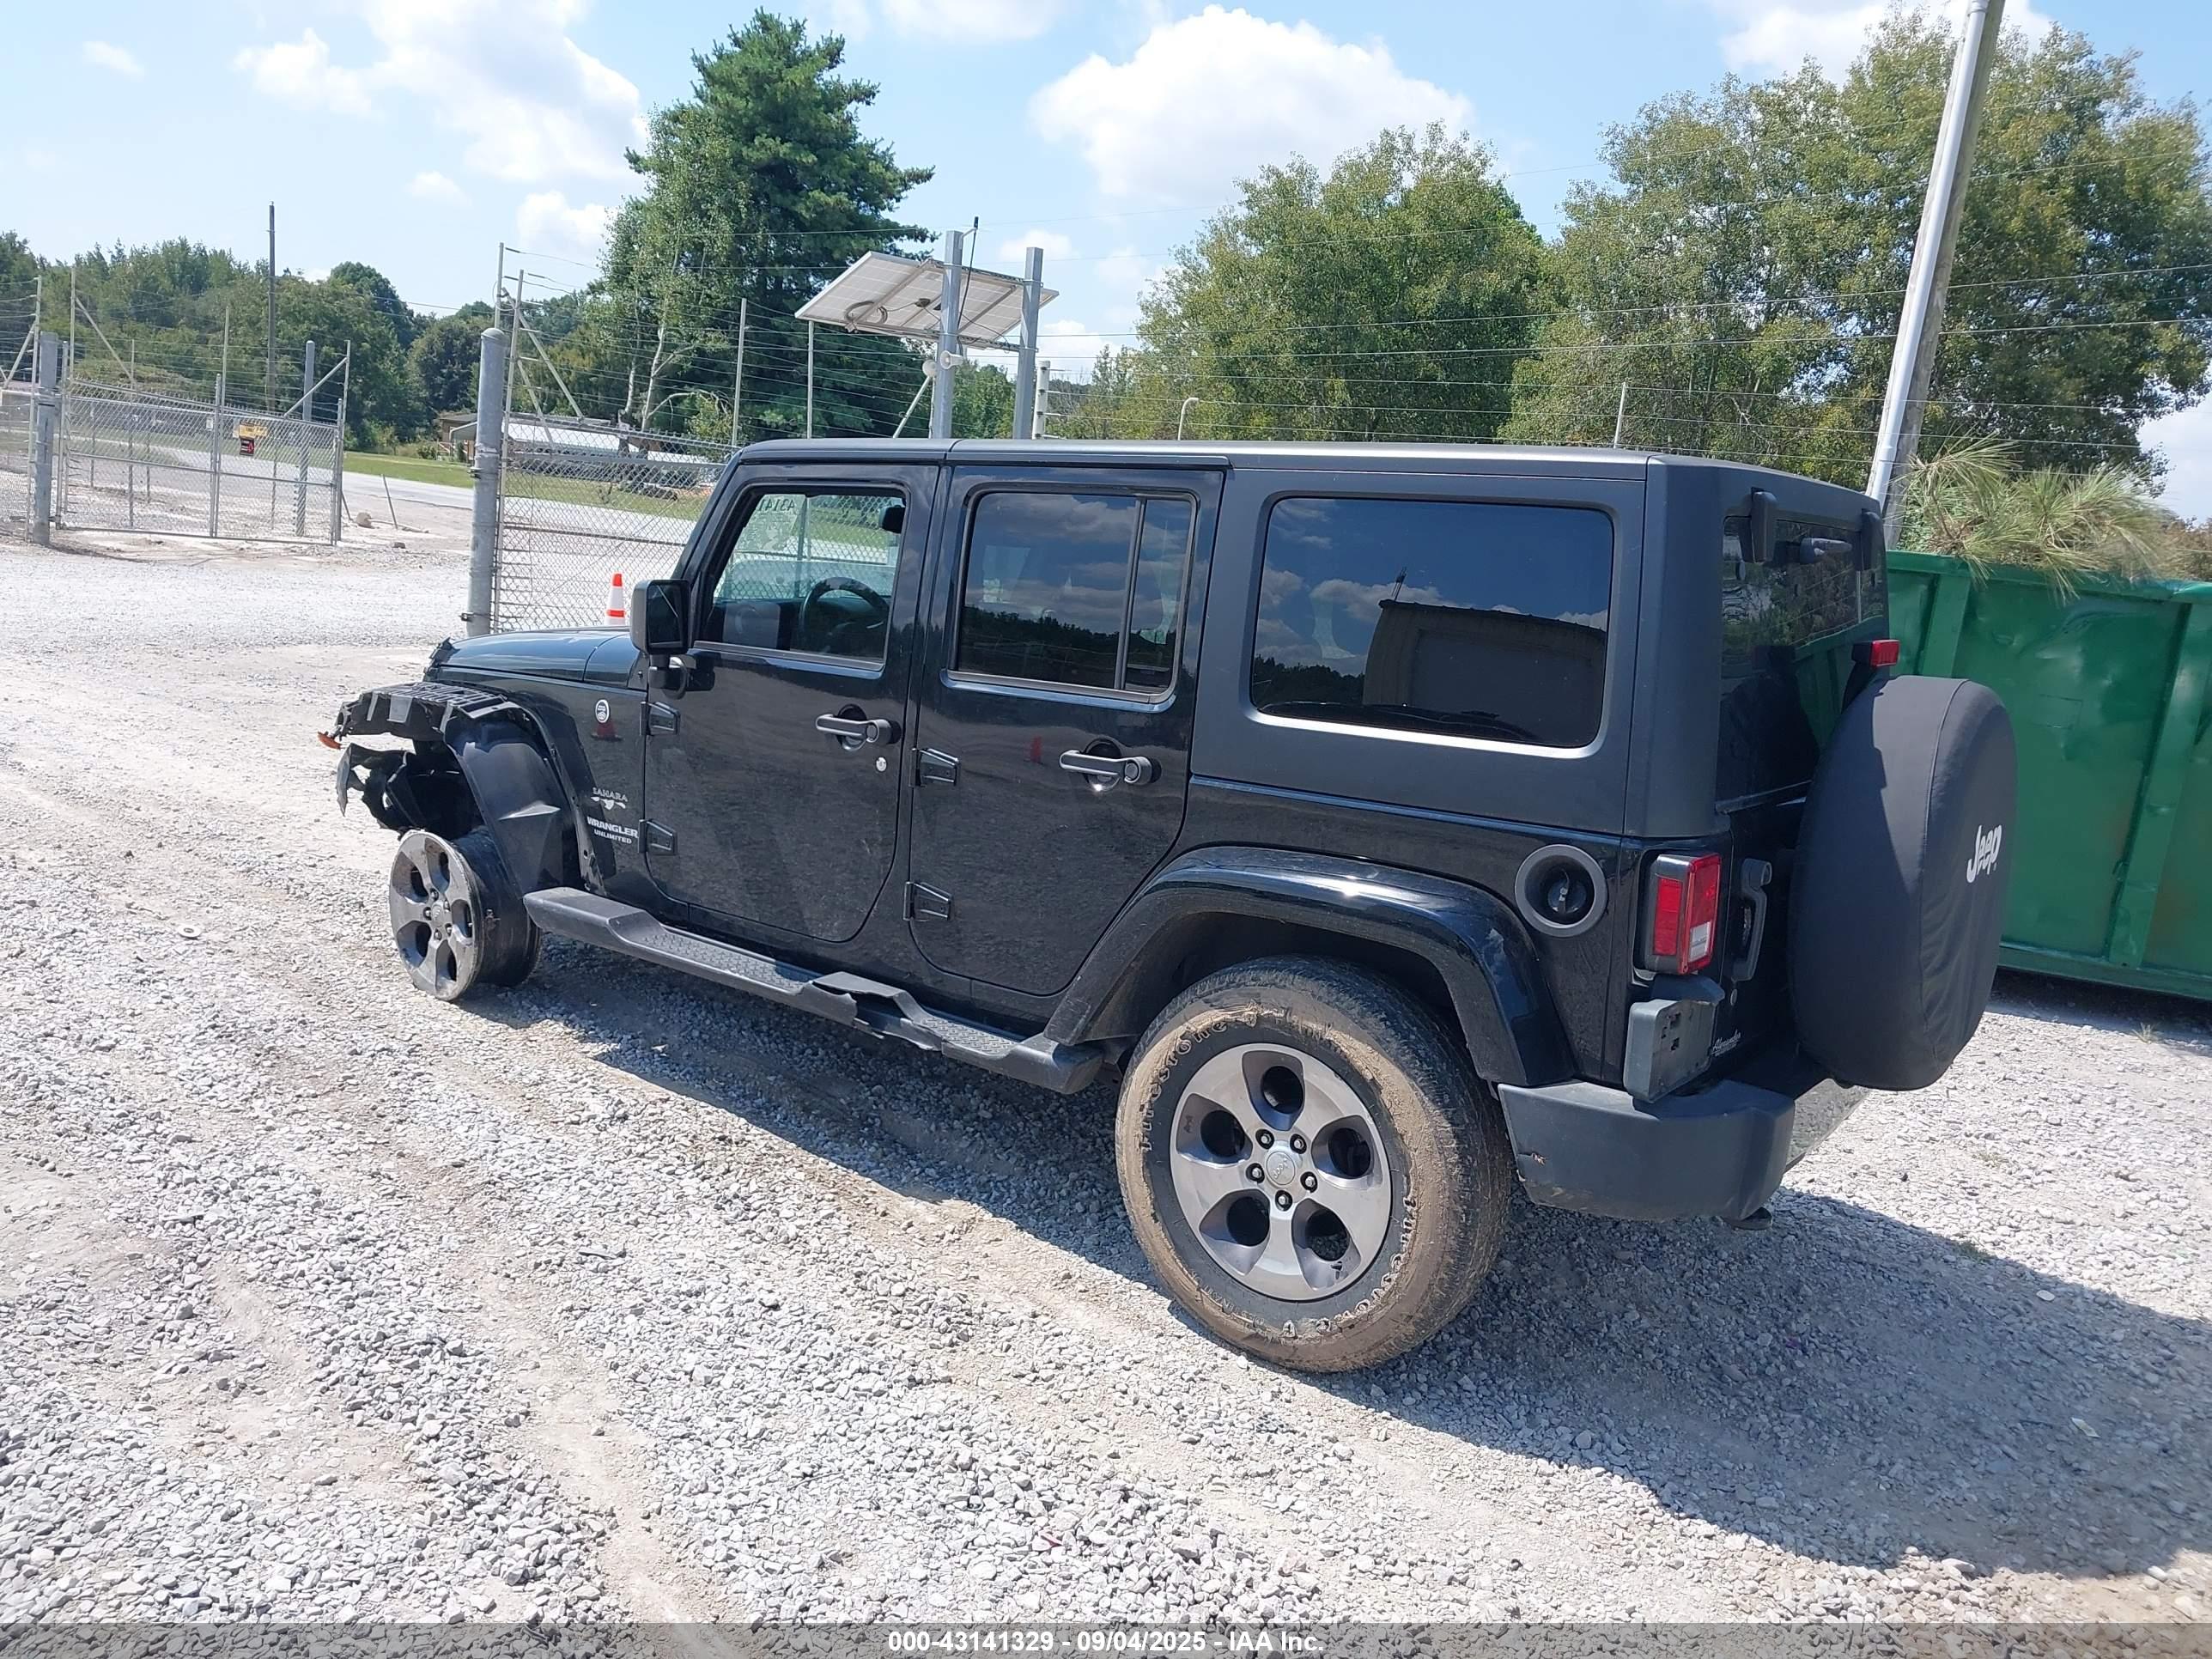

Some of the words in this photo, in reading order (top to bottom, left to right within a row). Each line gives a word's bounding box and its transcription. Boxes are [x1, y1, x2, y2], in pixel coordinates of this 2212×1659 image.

[592, 787, 629, 802] SAHARA
[586, 815, 639, 839] WRANGLER
[593, 829, 632, 844] UNLIMITED
[1966, 824, 2002, 884] Jeep
